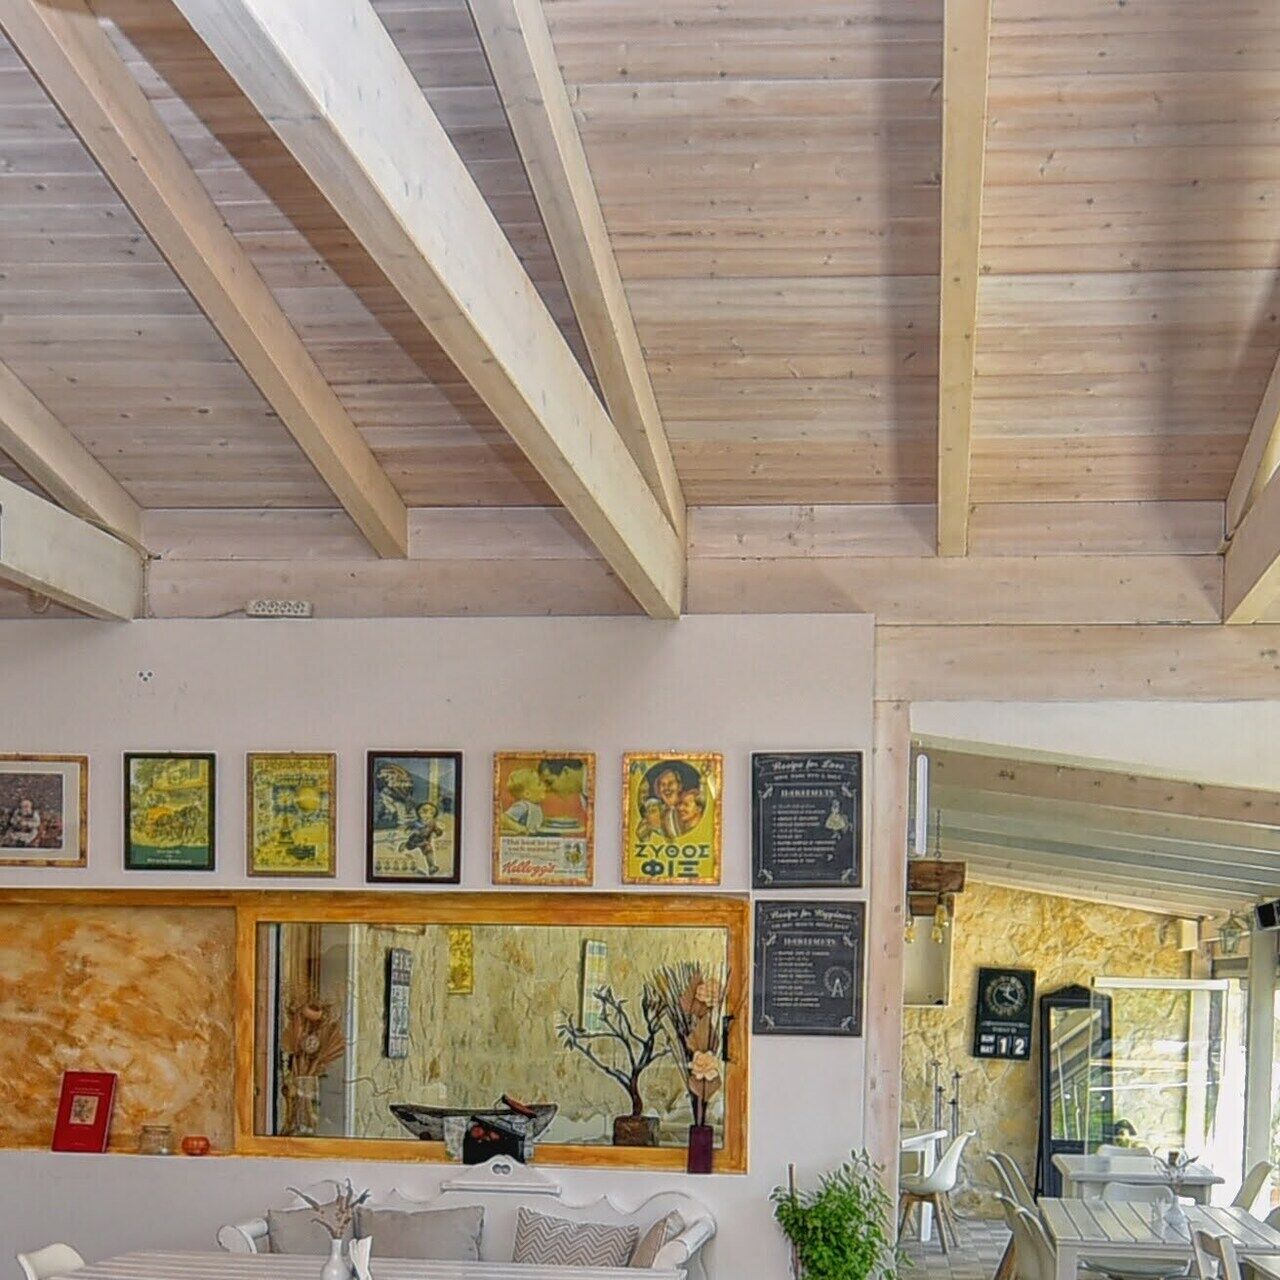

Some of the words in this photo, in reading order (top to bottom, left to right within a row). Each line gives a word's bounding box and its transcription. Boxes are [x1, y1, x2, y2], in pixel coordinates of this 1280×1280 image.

[635, 844, 711, 858] ΖΥΘΟΣ
[502, 859, 556, 878] Kellogg's
[641, 859, 699, 878] ΦΙΞ
